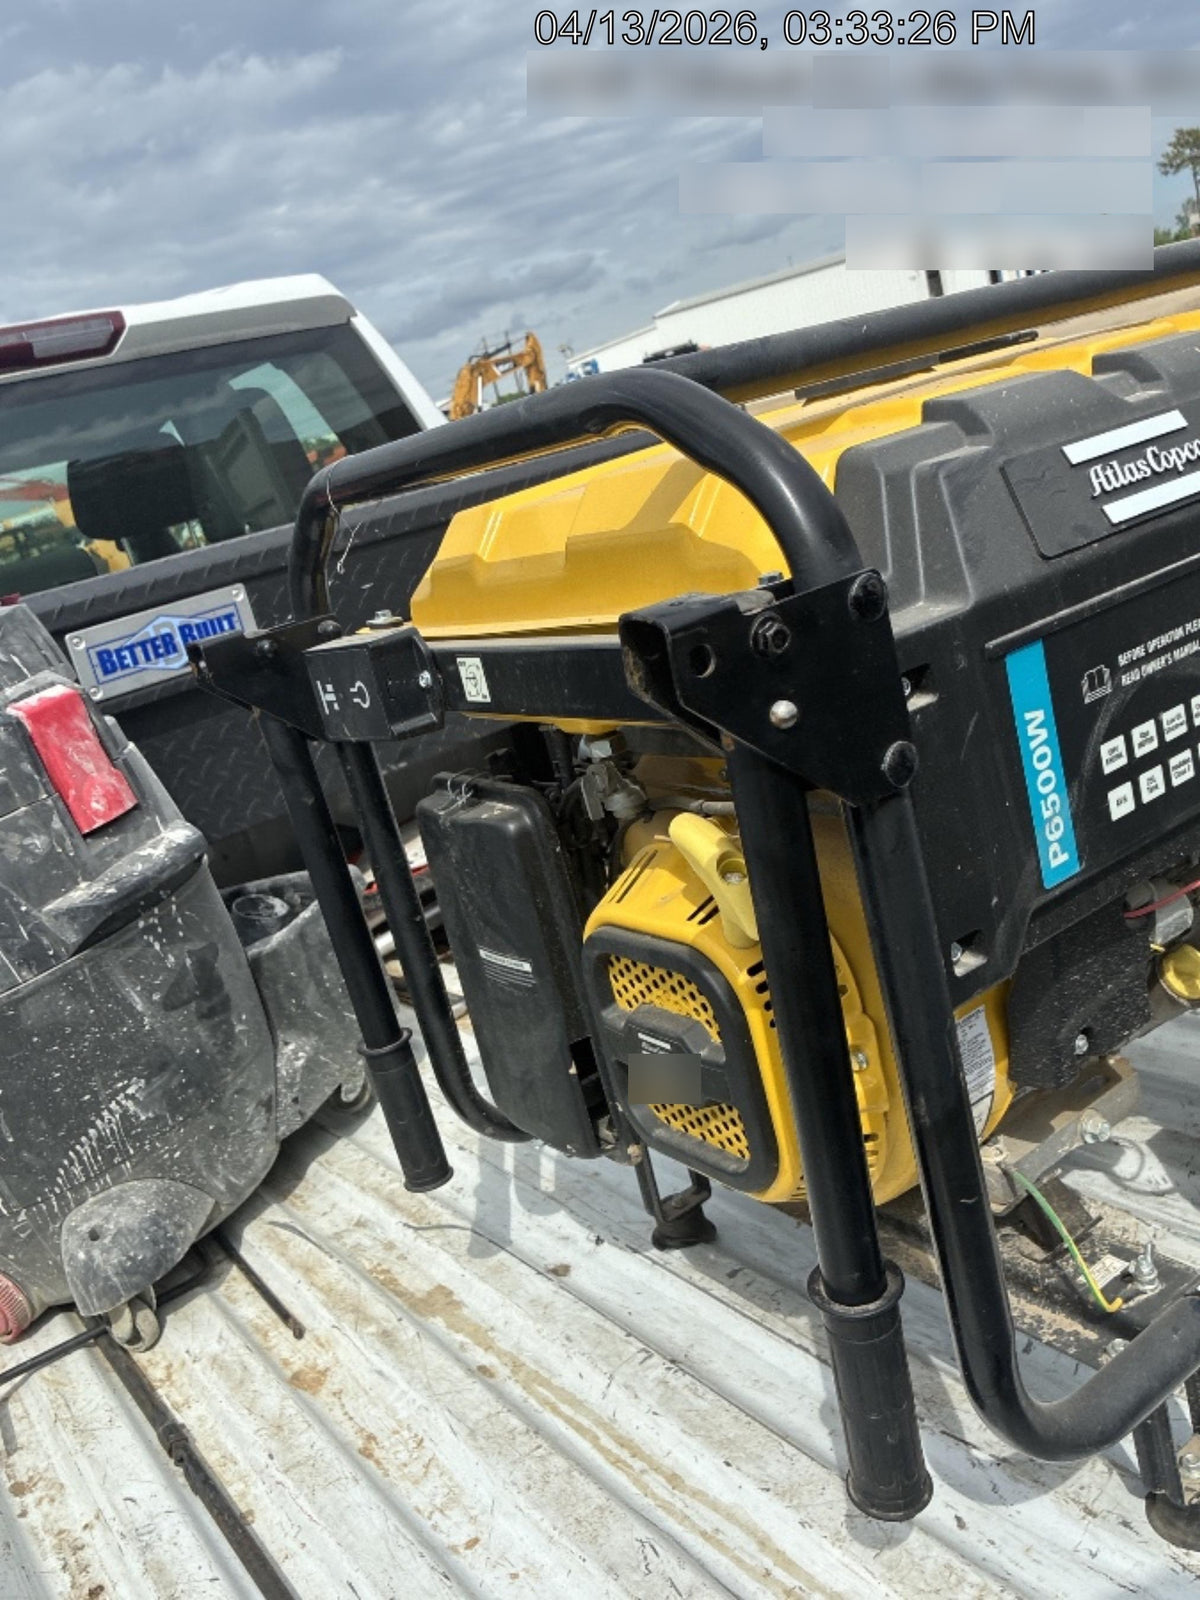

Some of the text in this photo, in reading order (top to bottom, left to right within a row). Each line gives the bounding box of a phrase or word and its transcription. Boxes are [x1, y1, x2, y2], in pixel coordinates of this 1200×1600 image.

[1089, 459, 1152, 497] Atlas
[96, 631, 179, 677] BETTER
[1117, 618, 1200, 668] BEFORE OPERATION PLE
[1121, 667, 1141, 687] READ
[1140, 651, 1173, 678] OWNER'S
[1023, 708, 1070, 869] P6500W
